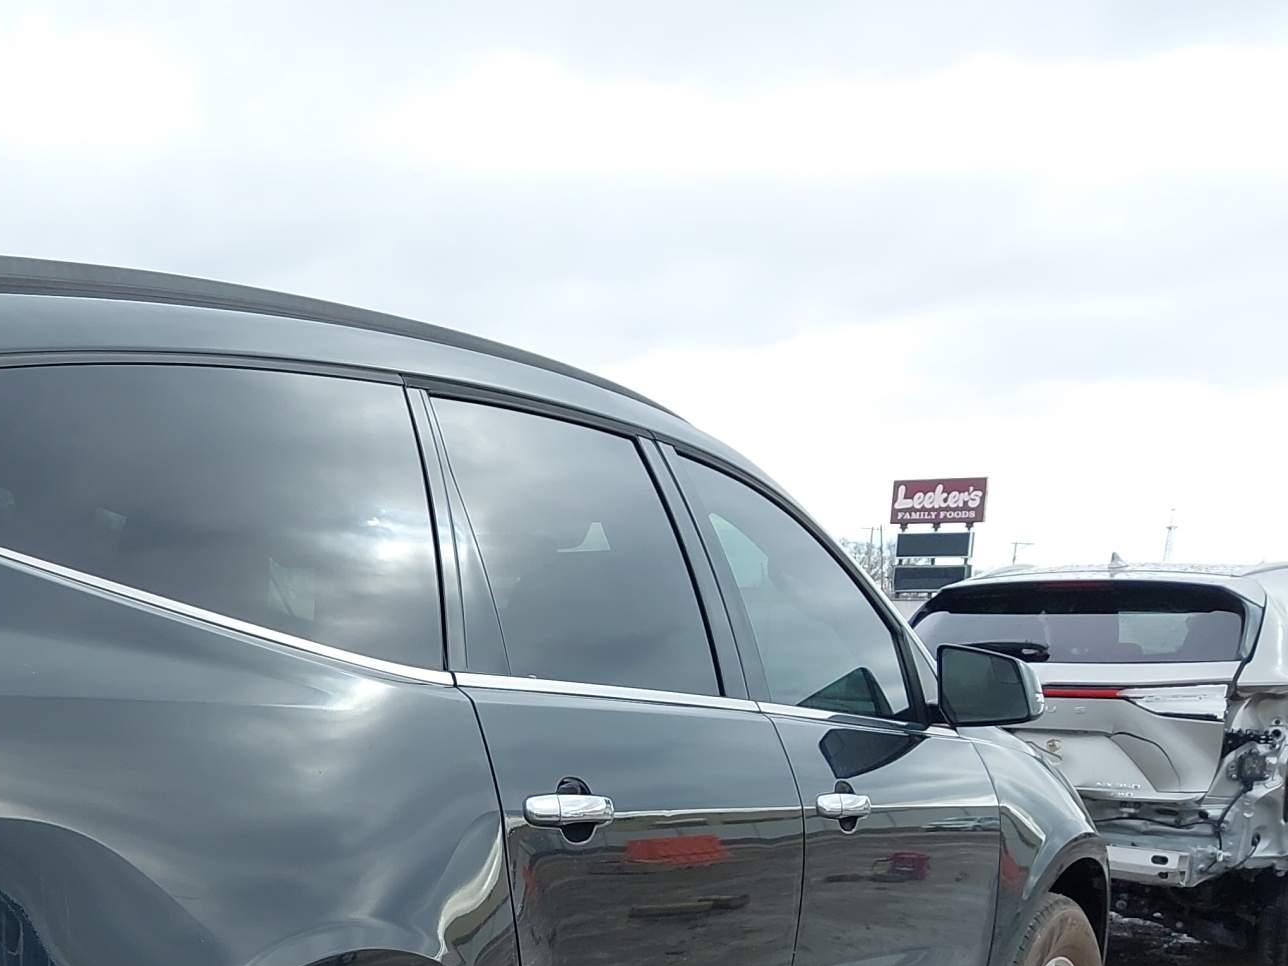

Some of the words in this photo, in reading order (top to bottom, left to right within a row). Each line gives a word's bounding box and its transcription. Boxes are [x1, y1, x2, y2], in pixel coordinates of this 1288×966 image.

[894, 484, 983, 509] Leeker's
[897, 511, 938, 520] FAMILY
[939, 510, 976, 519] FOODS
